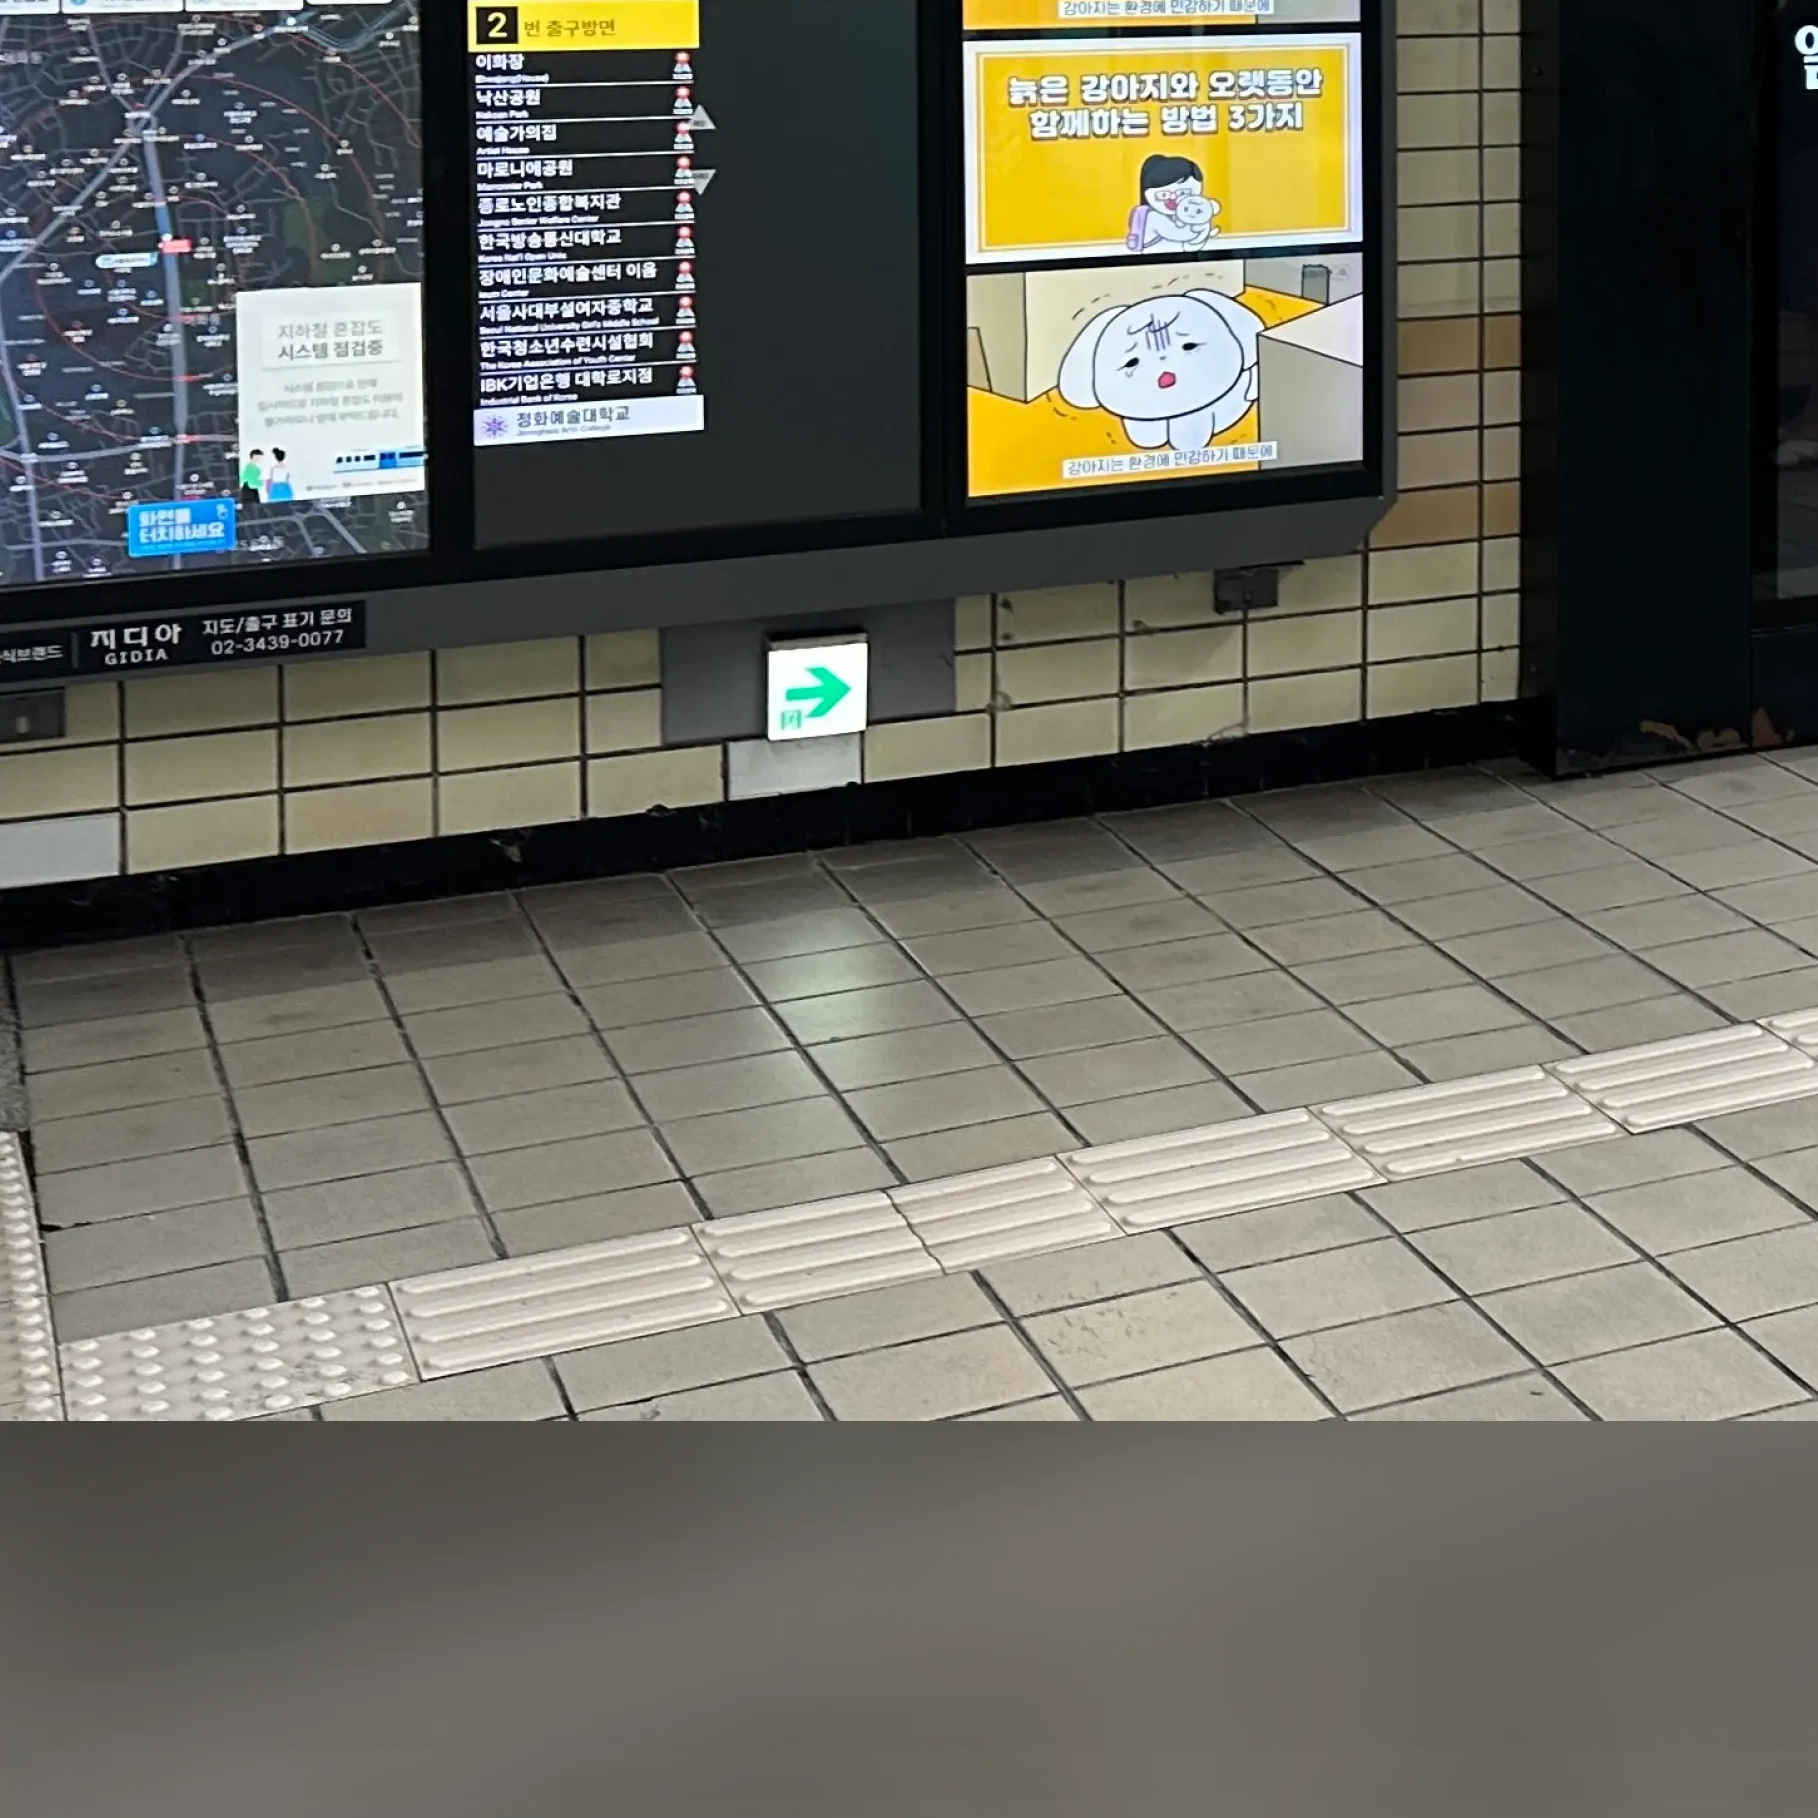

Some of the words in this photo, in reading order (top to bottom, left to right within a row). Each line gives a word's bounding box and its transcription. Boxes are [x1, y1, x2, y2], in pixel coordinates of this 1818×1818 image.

[1064, 0, 1121, 15] 강아지는
[486, 11, 508, 39] 2
[524, 19, 541, 38] 번
[546, 18, 616, 38] 출구방면
[475, 54, 525, 71] 이화장
[476, 89, 541, 107] 낙산공원
[1008, 74, 1070, 107] 늙은
[1080, 71, 1199, 104] 강아지와
[1208, 68, 1324, 101] 오랫동안
[1029, 109, 1150, 141] 함께하는
[1161, 105, 1219, 136] 방법
[1228, 102, 1304, 132] 3가지
[476, 159, 574, 178] 마로니에공원
[478, 228, 622, 251] 한국방송통신대학교
[626, 261, 657, 279] 이음
[278, 341, 329, 361] 시스템
[333, 339, 384, 358] 점검중
[480, 371, 571, 393] IBK기업은행
[575, 367, 653, 387] 대학로지점
[517, 405, 630, 428] 정화예술대학교
[1068, 458, 1124, 476] 강아지는
[202, 614, 279, 636] 지도/출구
[282, 610, 315, 630] 표기
[319, 606, 352, 626] 문의
[211, 629, 344, 655] 02-3439-0077
[104, 648, 169, 665] GIDIA
